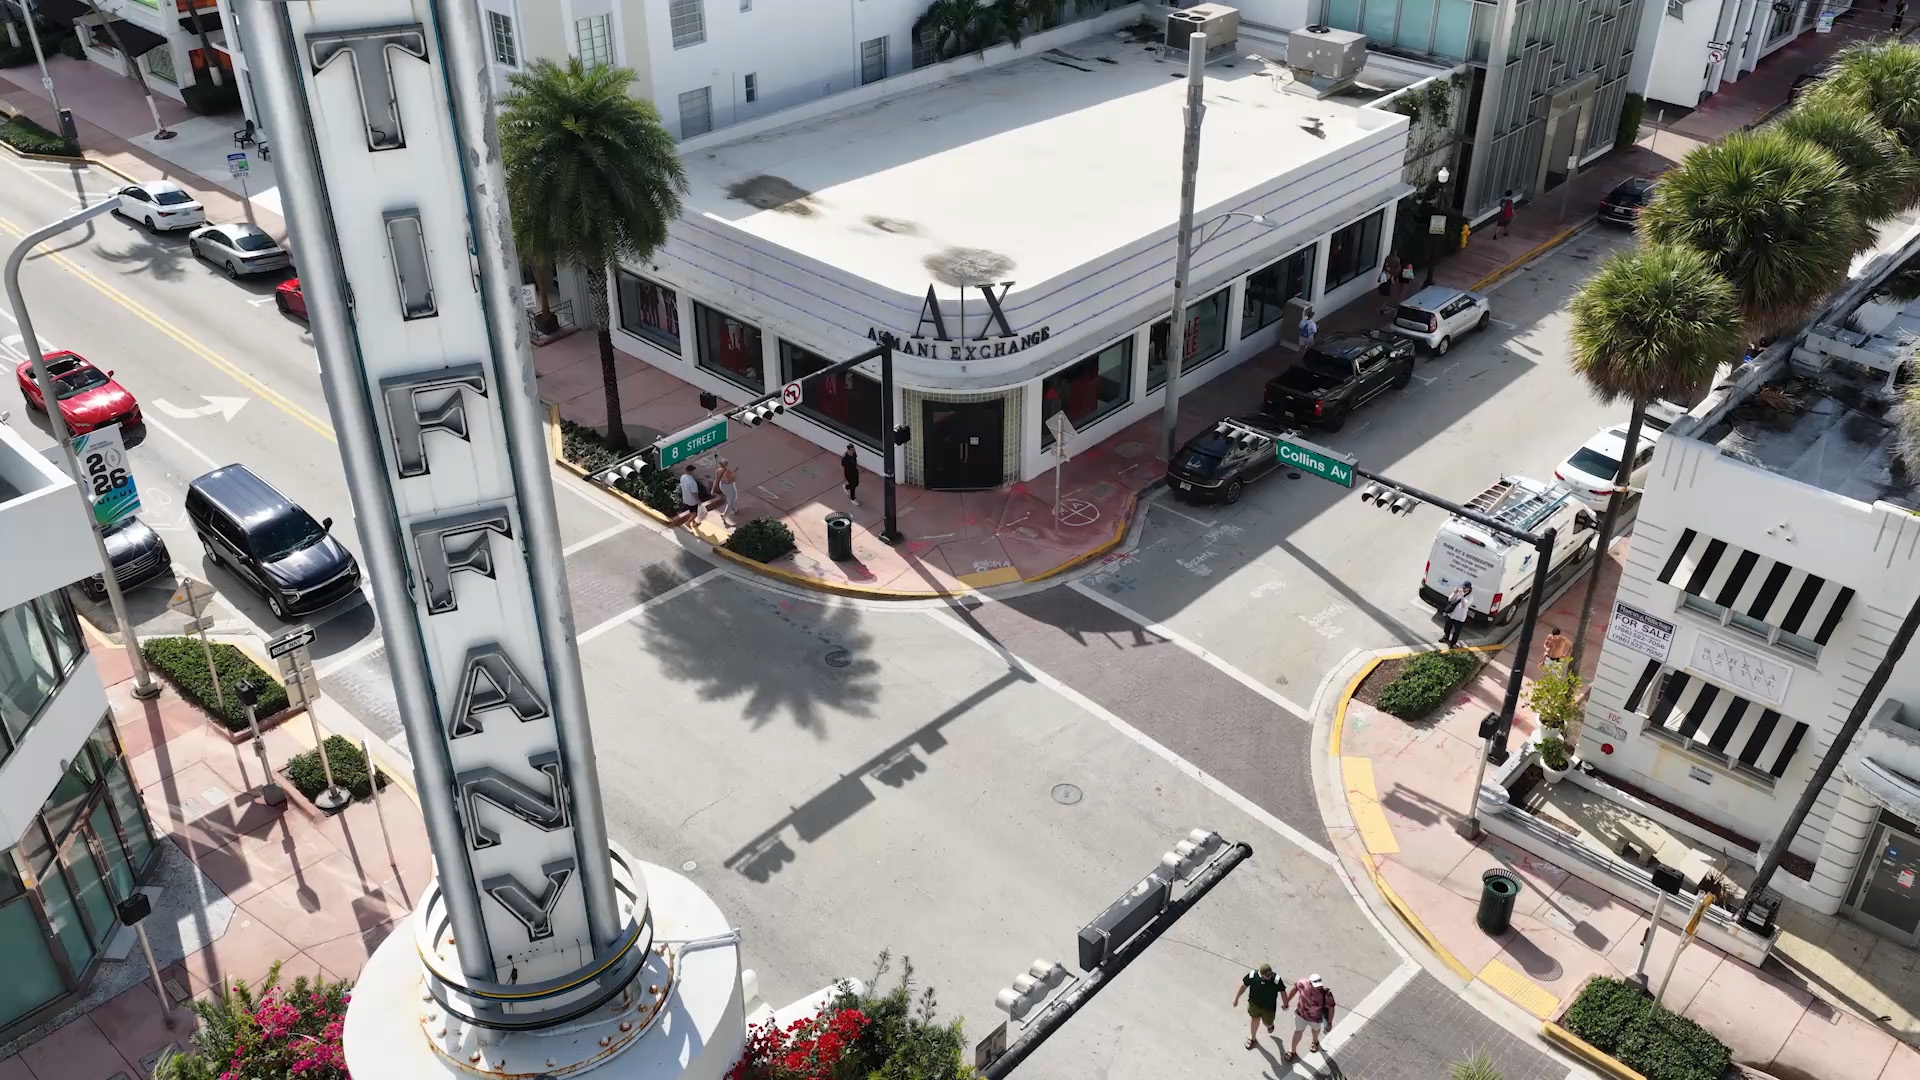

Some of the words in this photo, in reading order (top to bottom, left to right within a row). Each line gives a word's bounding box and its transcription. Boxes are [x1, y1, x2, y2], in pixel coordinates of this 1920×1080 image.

[951, 326, 1050, 361] EXCHANGE
[672, 447, 679, 459] 8
[687, 430, 717, 451] STREET
[1280, 446, 1325, 471] Collins
[1331, 465, 1347, 480] Av
[93, 468, 128, 495] 26
[304, 22, 573, 943] TIFFANY
[1615, 613, 1638, 628] FOR
[1642, 625, 1671, 642] SALE
[274, 644, 286, 654] ONE
[289, 639, 301, 649] WAY
[1608, 713, 1621, 724] FDC
